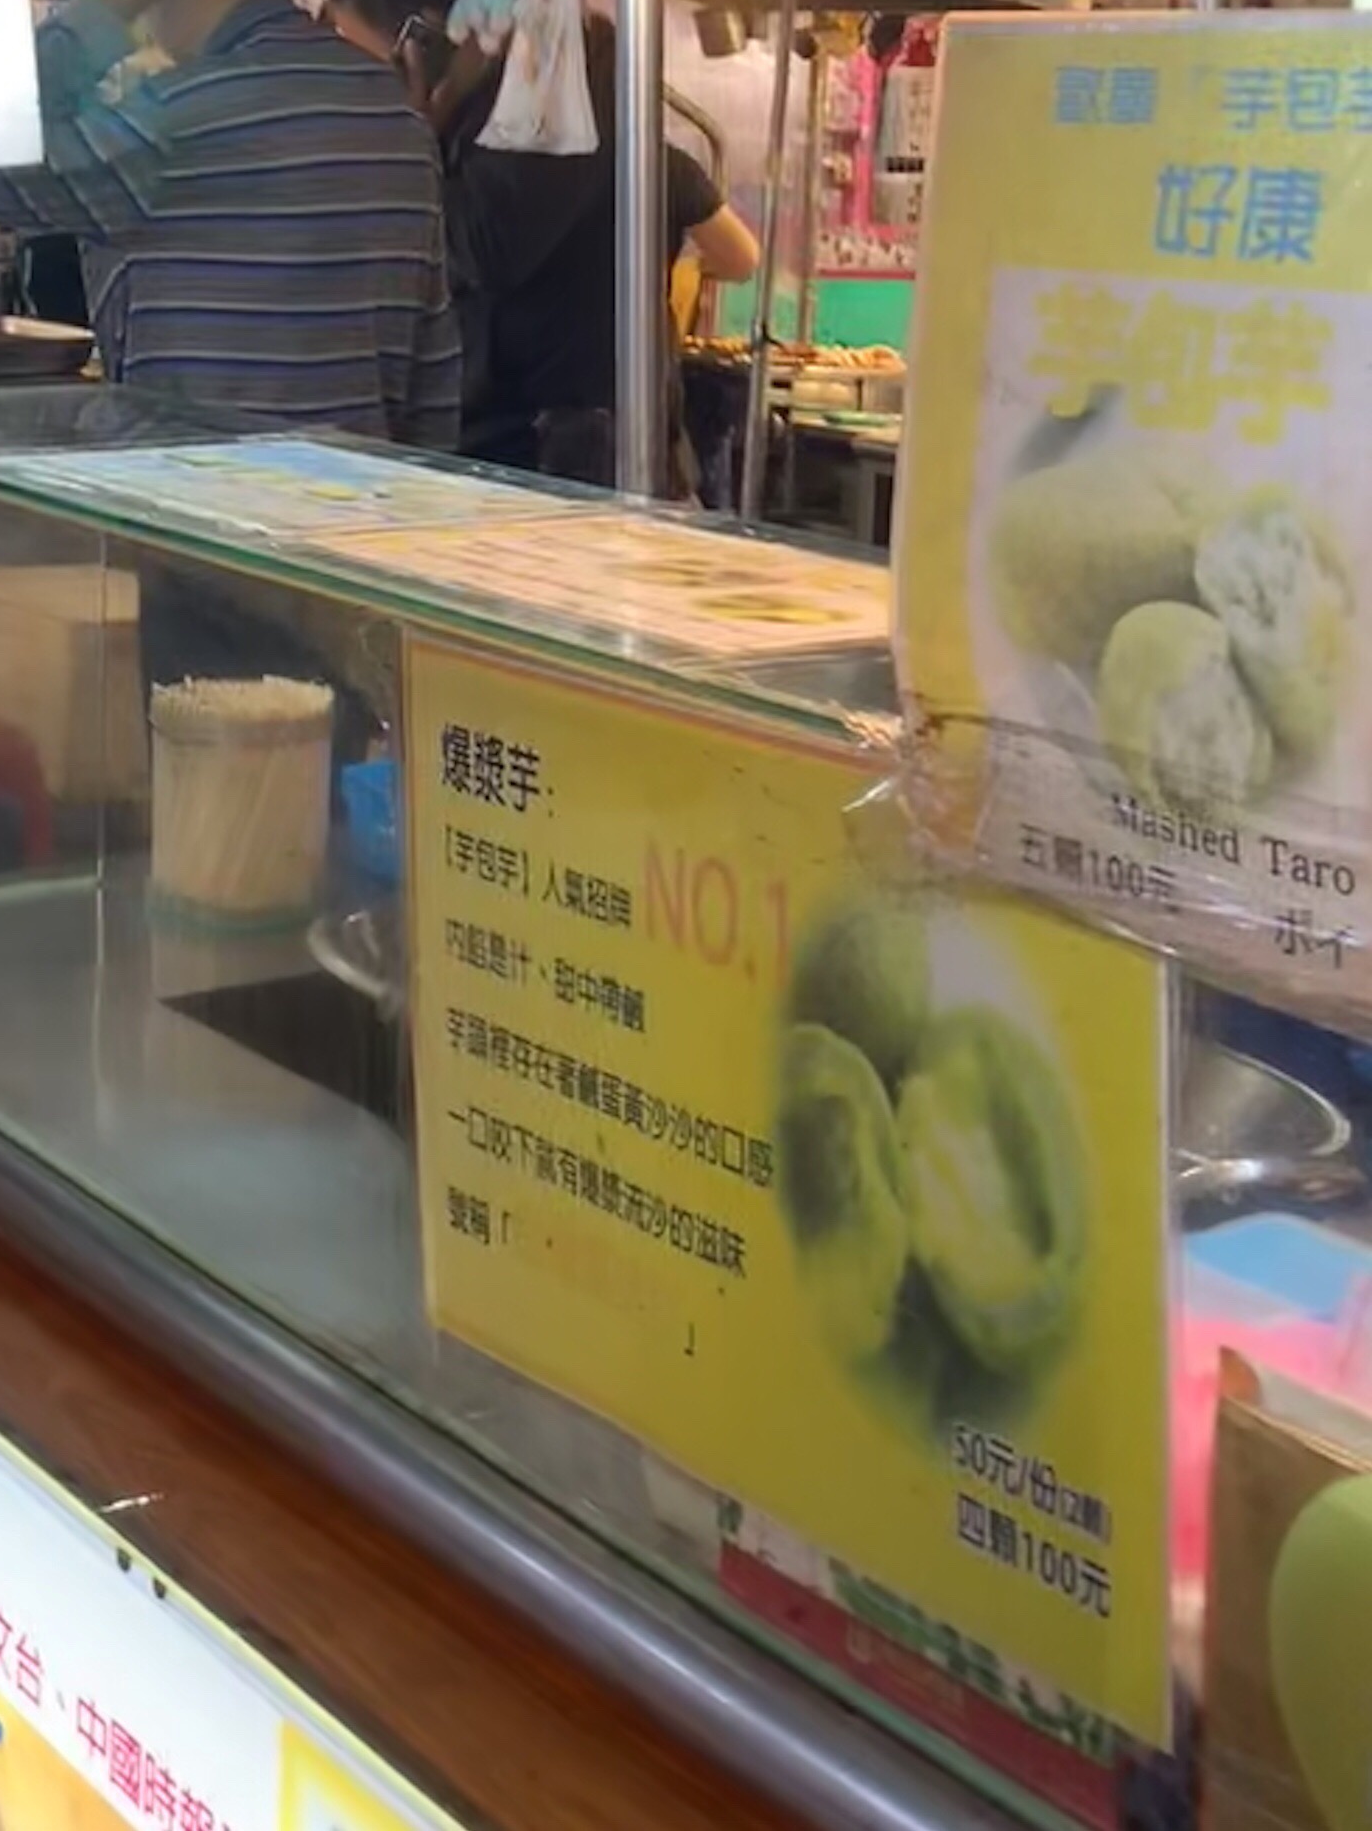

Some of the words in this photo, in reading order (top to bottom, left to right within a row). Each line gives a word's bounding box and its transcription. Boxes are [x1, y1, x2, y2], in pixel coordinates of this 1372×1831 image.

[1154, 163, 1324, 263] 好康
[1109, 792, 1242, 864] Mashed
[1260, 835, 1356, 896] Taro
[958, 1490, 1112, 1619] 四顆100元
